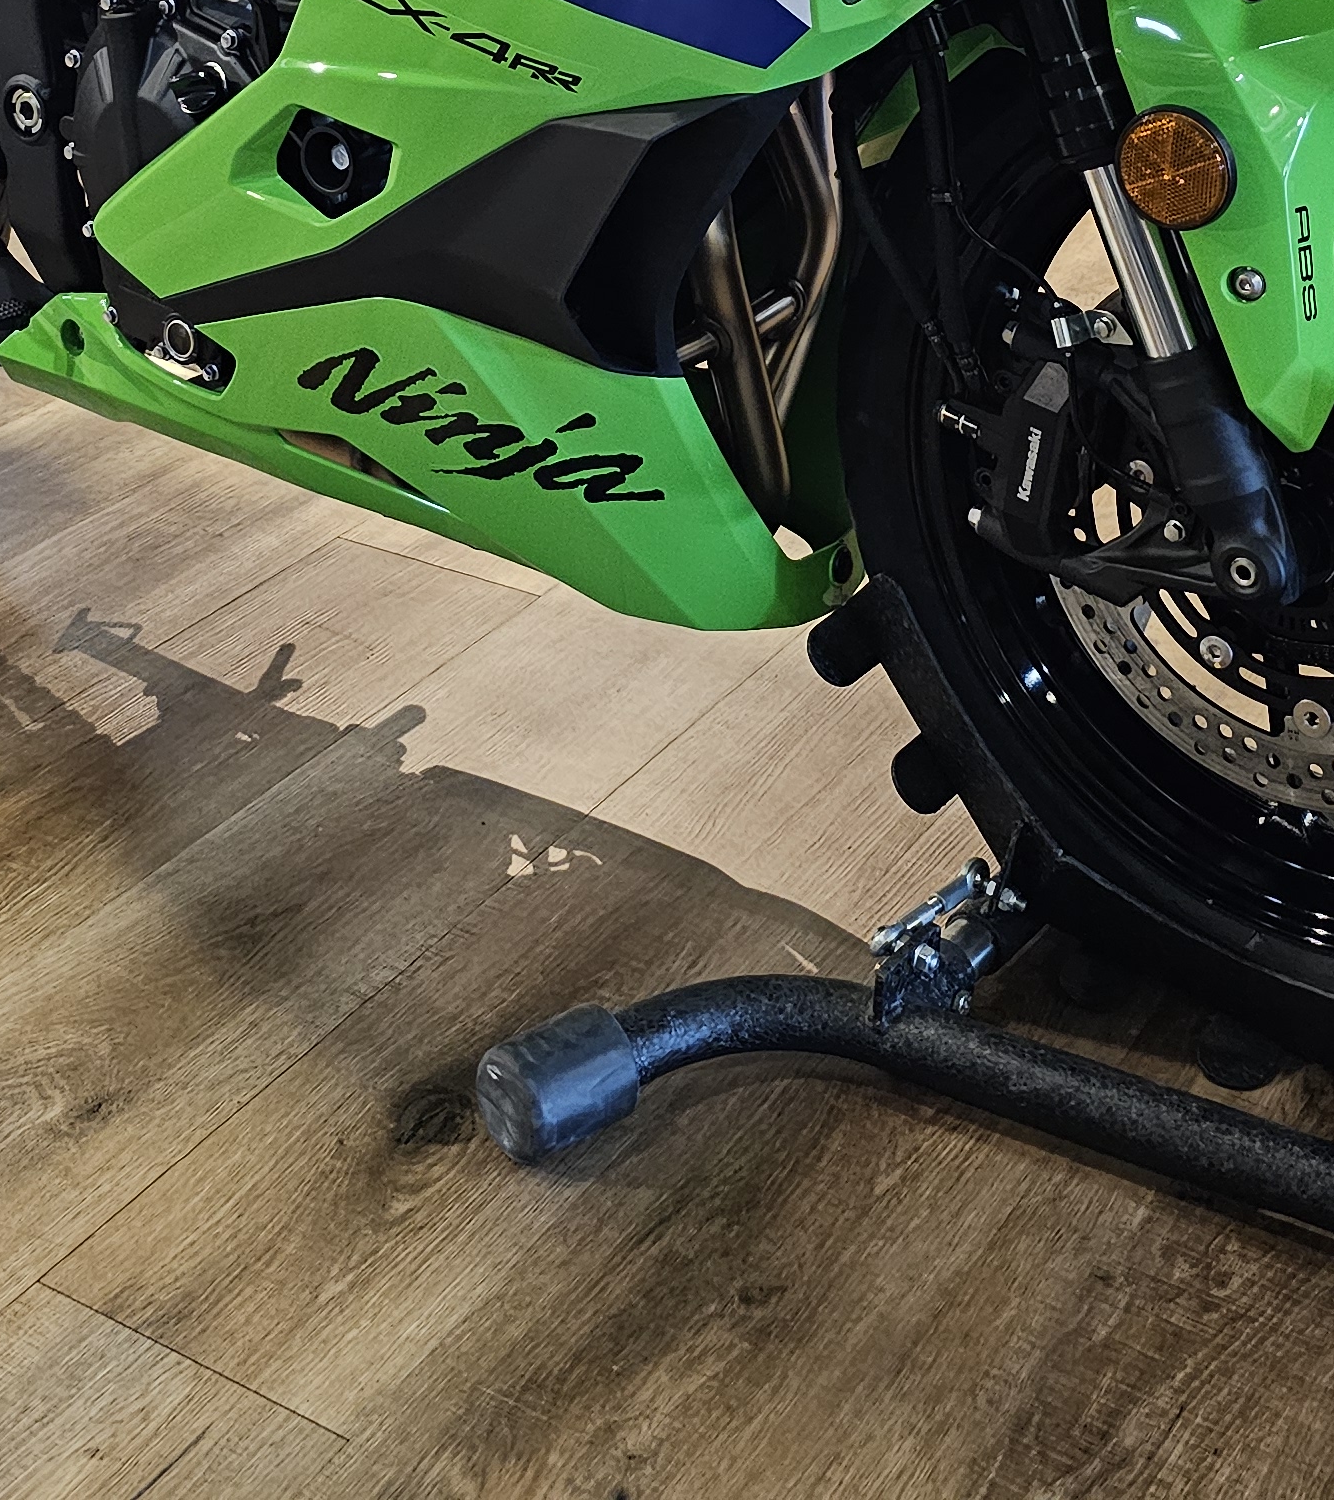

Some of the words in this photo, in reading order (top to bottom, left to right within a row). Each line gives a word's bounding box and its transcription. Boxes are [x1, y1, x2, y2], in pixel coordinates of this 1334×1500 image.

[1293, 204, 1318, 323] ABS
[296, 344, 666, 505] Ninja
[1015, 425, 1044, 504] Kawasaki
